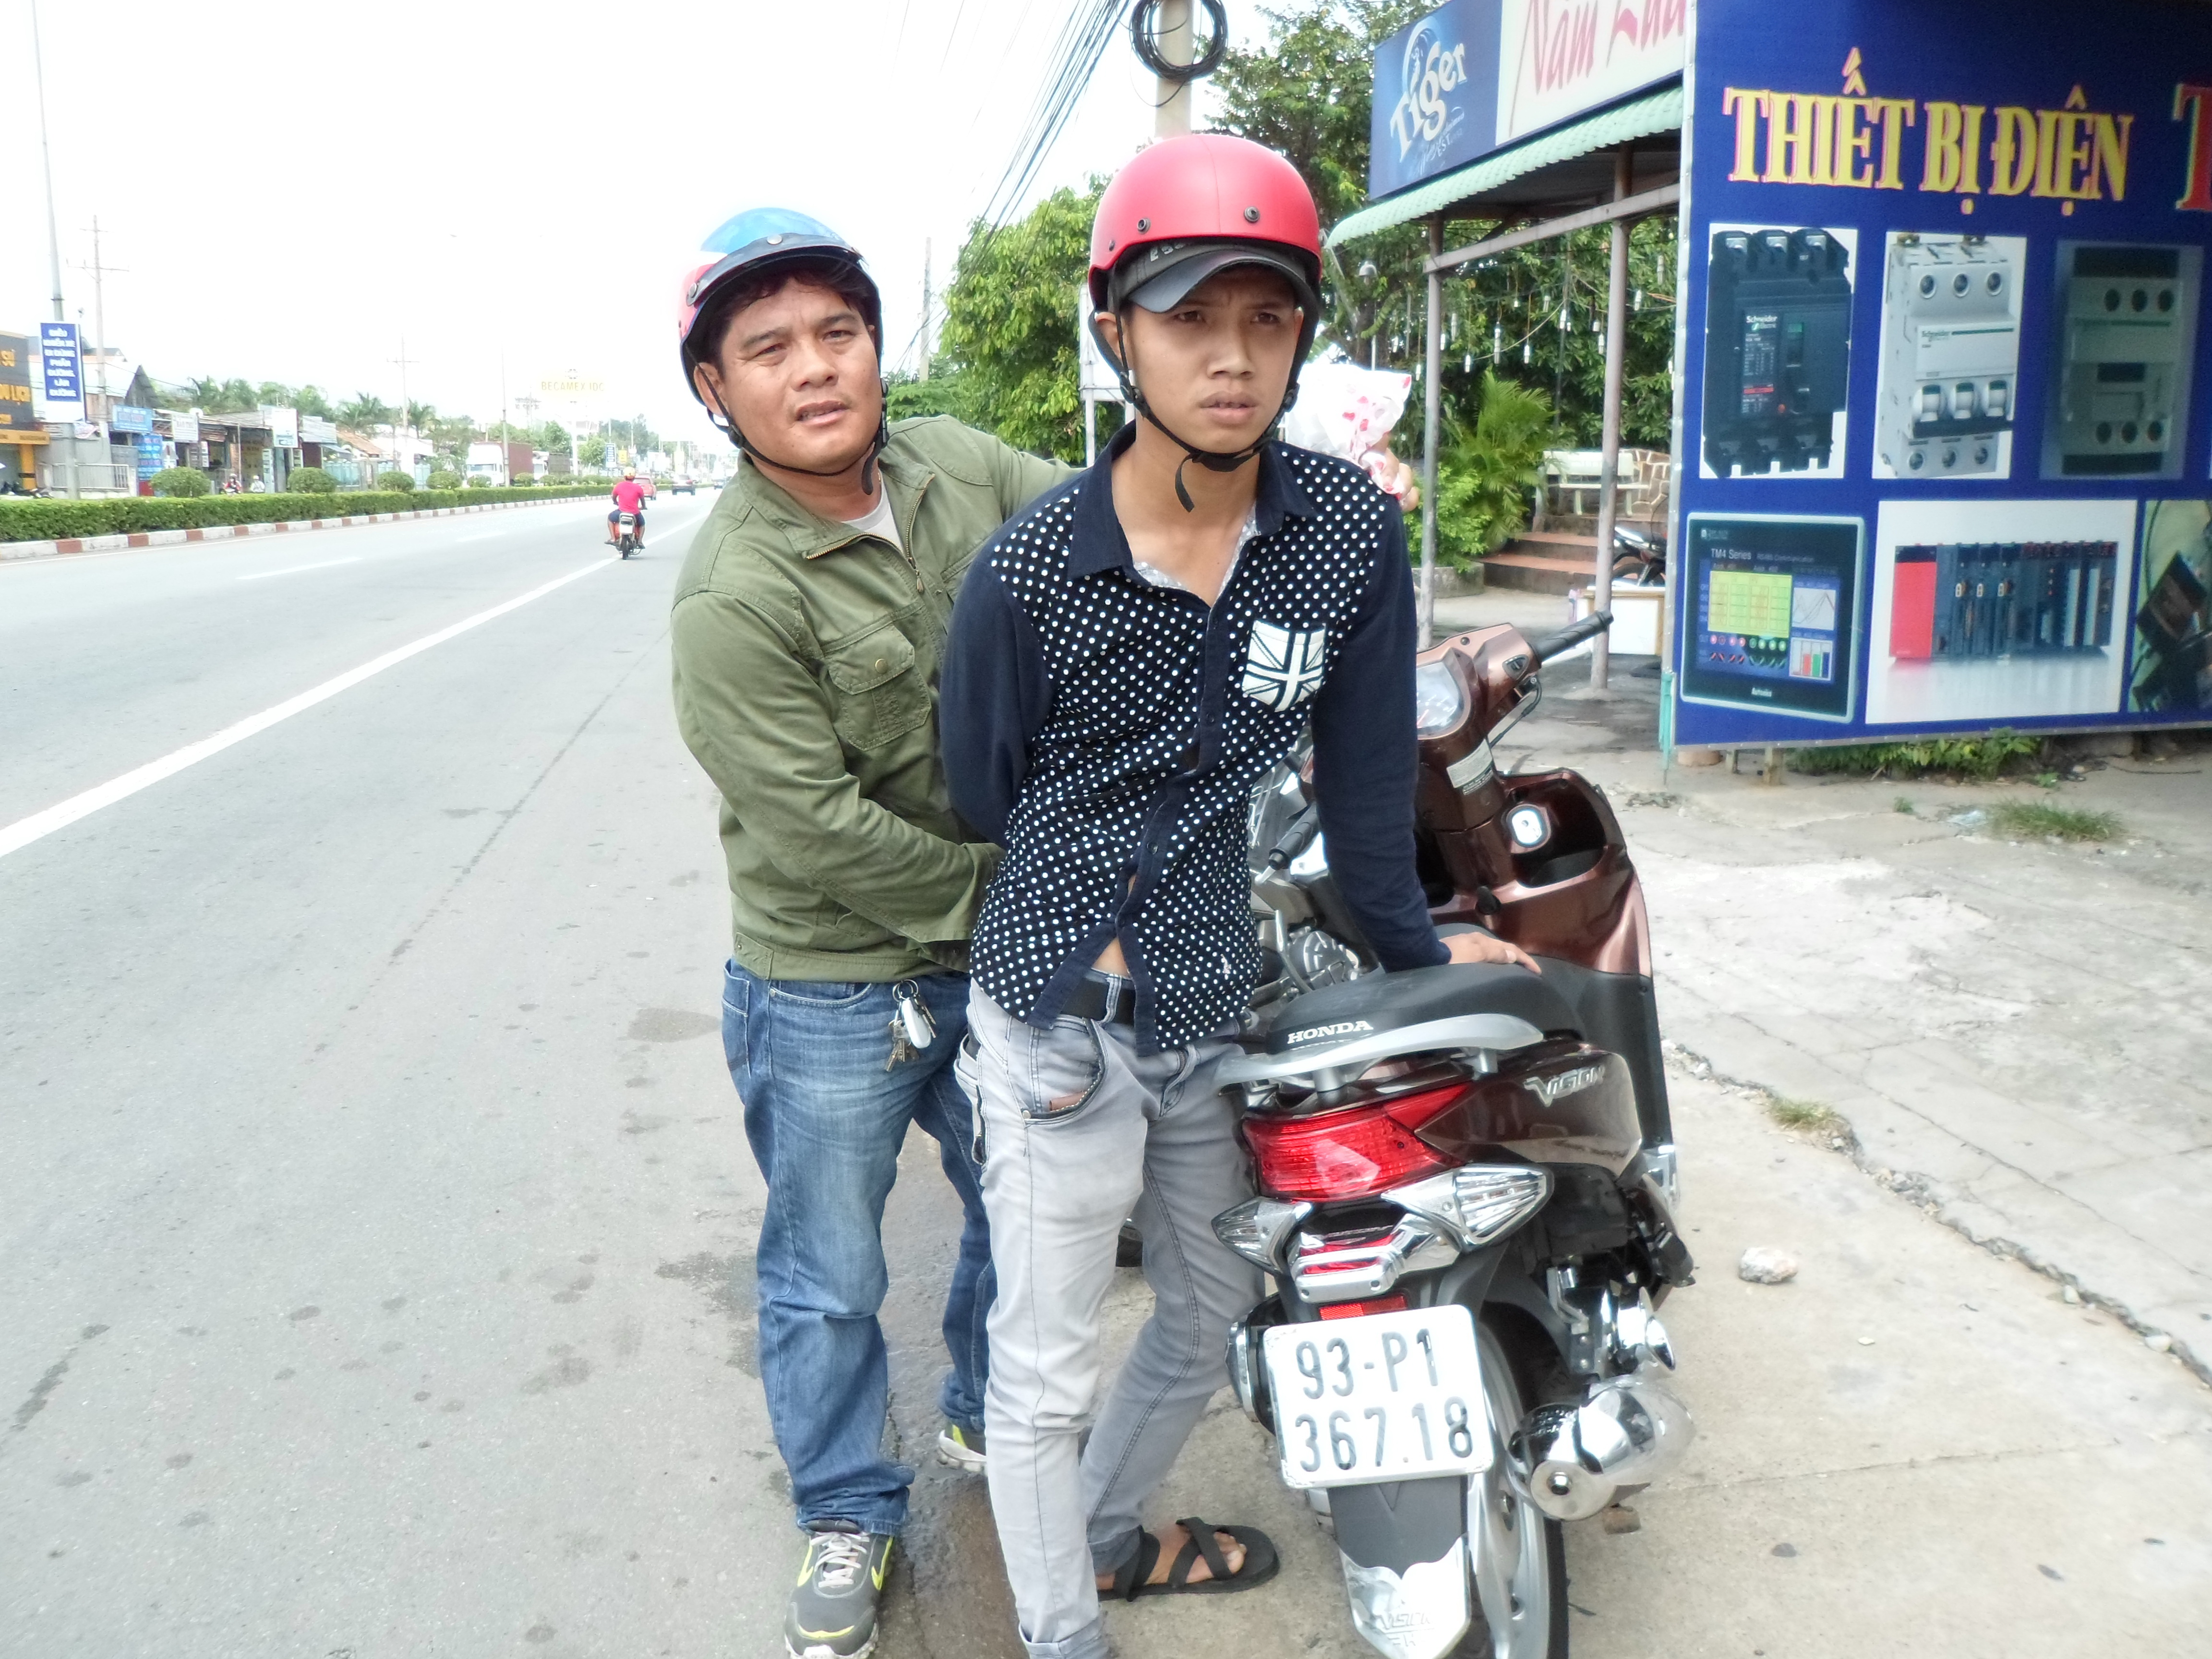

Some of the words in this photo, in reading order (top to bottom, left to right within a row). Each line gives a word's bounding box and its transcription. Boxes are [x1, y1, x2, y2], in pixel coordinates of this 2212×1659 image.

[1390, 41, 1467, 163] Tiger
[1722, 46, 1915, 191] THIẾT
[1920, 101, 1987, 216] BỊ
[1988, 84, 2134, 216] ĐIỆN
[541, 381, 586, 391] BECAMEX
[589, 382, 604, 391] IDC
[1729, 549, 1752, 560] Series
[1286, 1020, 1373, 1045] HONDA
[1295, 1328, 1439, 1400] 93-P1
[1295, 1395, 1473, 1472] 367.18
